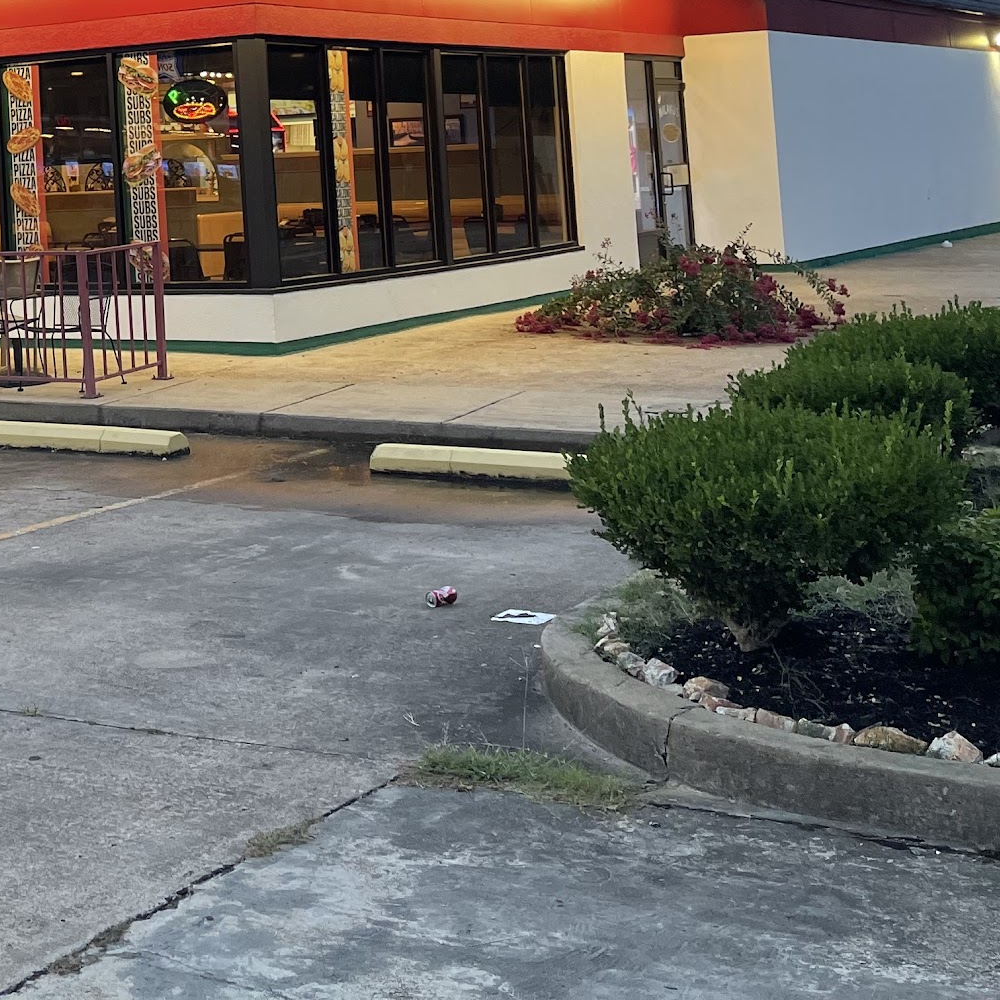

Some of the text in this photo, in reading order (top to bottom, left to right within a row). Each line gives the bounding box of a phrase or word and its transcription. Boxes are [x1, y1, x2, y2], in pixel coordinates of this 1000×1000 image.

[127, 96, 150, 110] SUBS
[11, 107, 32, 121] PIZZA
[128, 110, 151, 125] SUBS
[129, 125, 152, 140] SUBS
[14, 163, 35, 177] PIZZA
[132, 186, 156, 201] SUBS
[133, 200, 157, 215] SUBS
[16, 218, 38, 231] PIZZA
[134, 215, 158, 229] SUBS
[17, 231, 39, 245] PIZZA
[135, 229, 158, 242] SUBS
